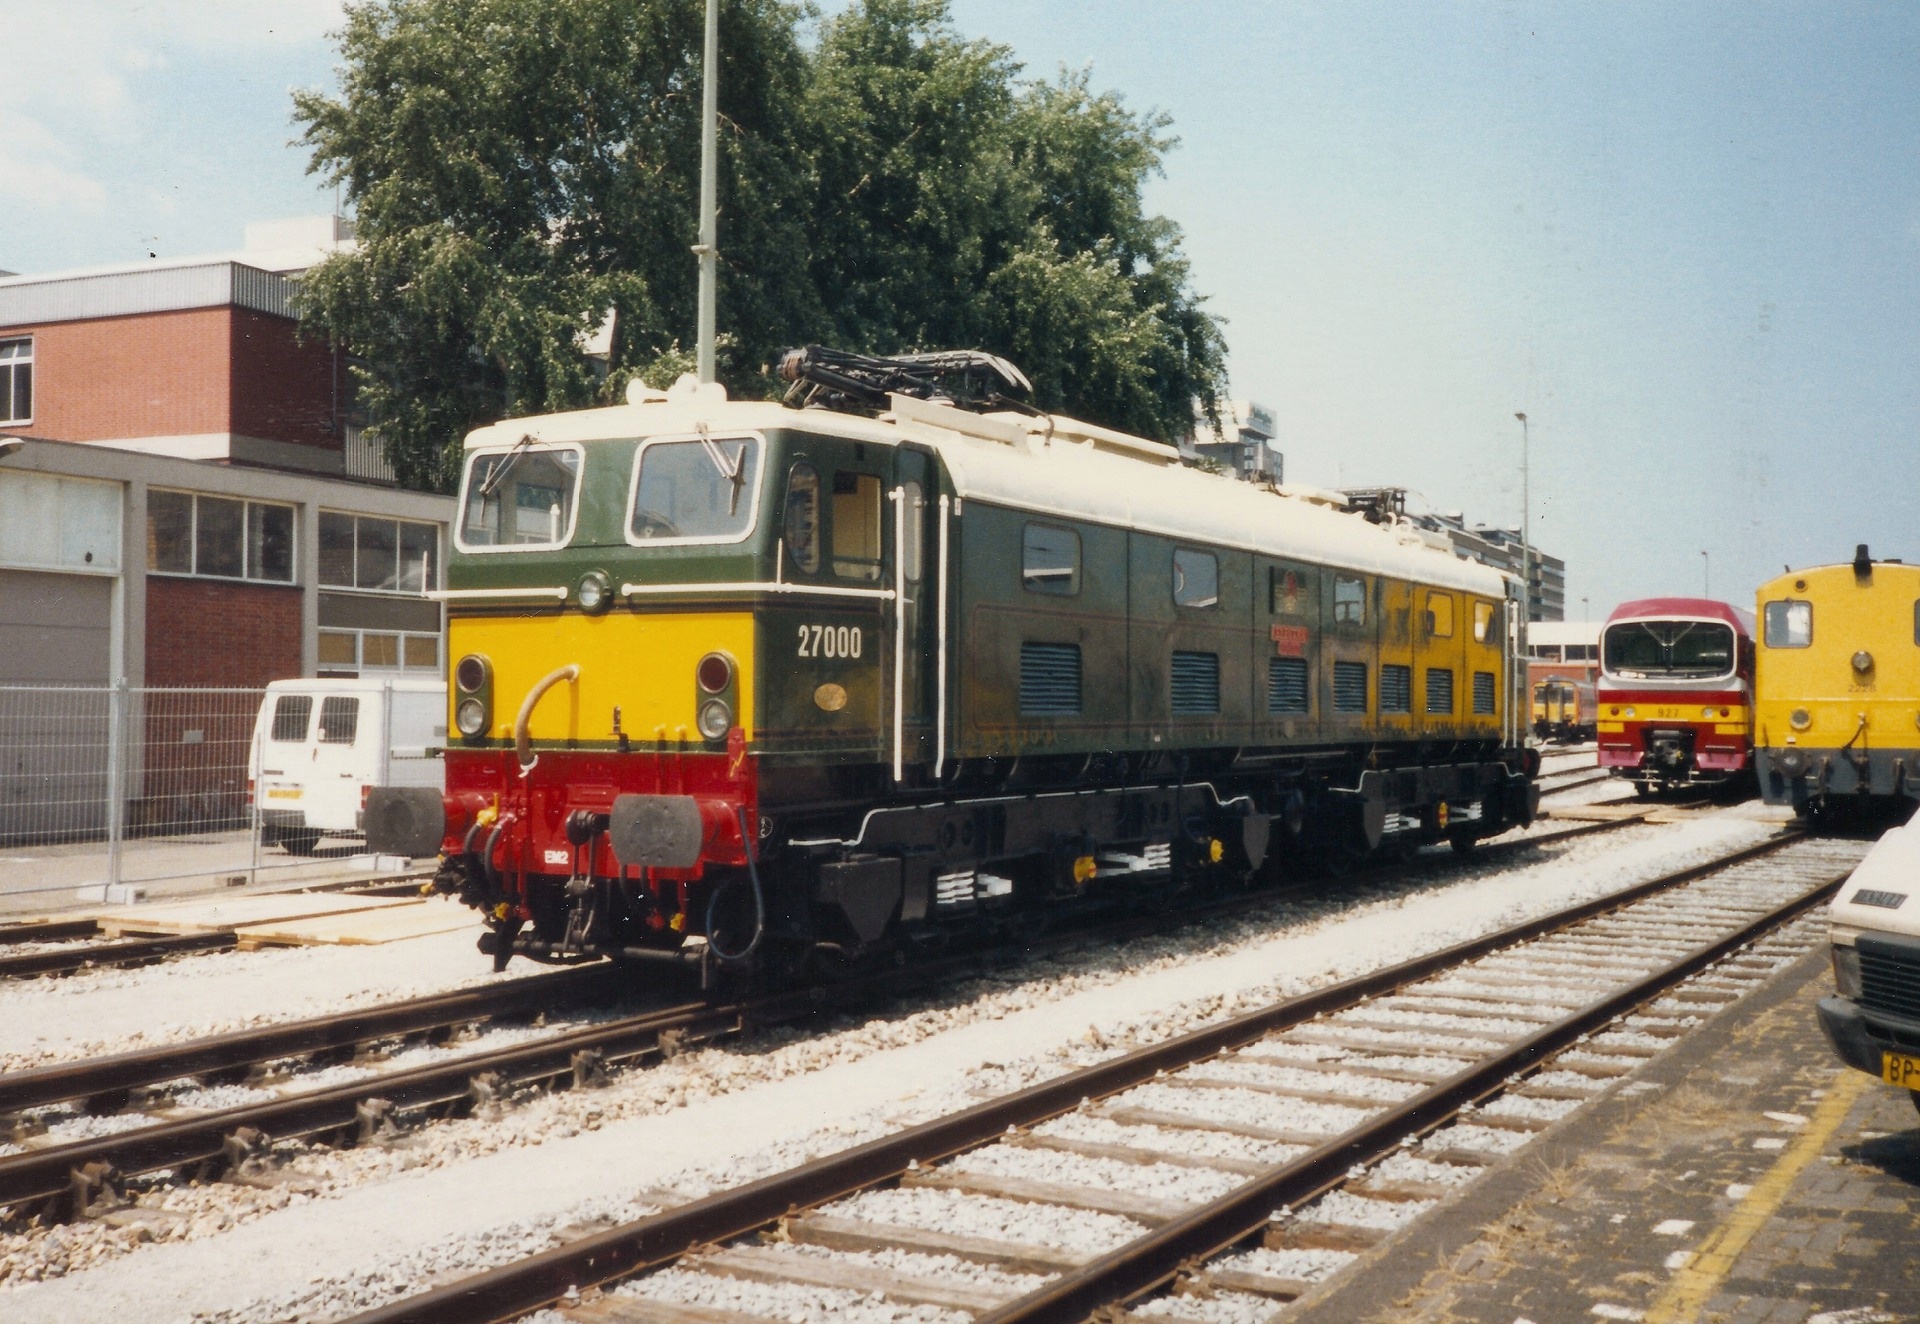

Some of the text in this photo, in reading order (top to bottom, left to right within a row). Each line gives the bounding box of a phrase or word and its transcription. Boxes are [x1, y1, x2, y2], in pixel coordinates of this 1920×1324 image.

[797, 624, 862, 659] 27000
[1657, 707, 1679, 719] 927
[544, 850, 569, 865] EM2
